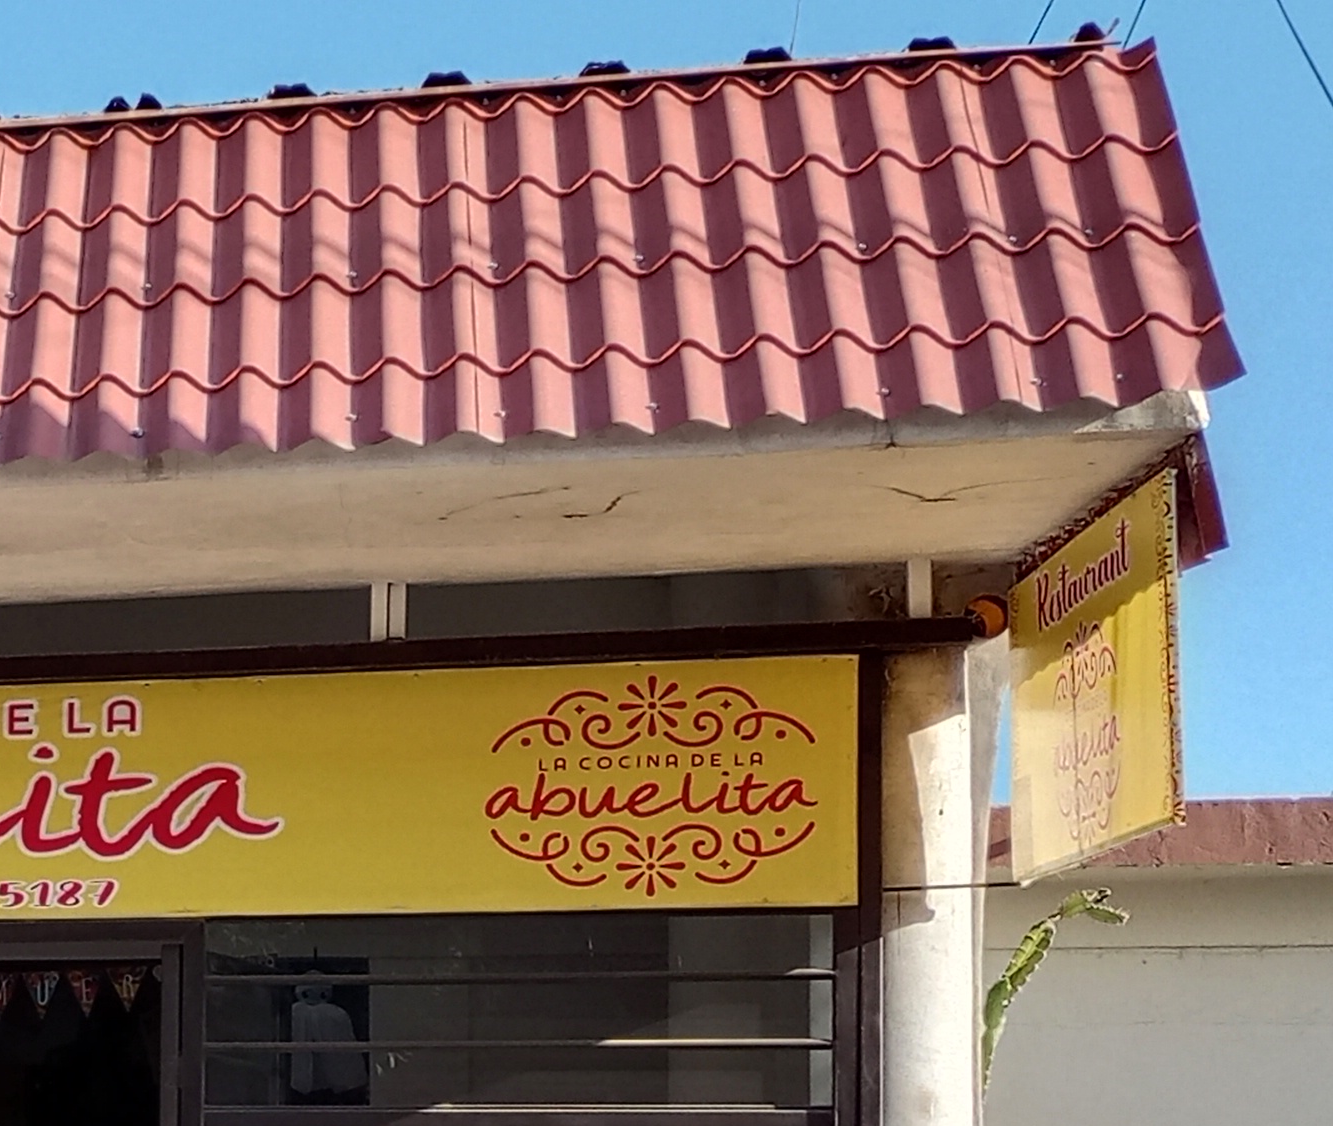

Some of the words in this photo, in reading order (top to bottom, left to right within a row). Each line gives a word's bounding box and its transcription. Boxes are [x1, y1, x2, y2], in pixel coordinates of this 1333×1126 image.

[1035, 519, 1130, 633] Restaurant
[66, 699, 138, 734] LA
[538, 757, 567, 772] LA
[578, 754, 679, 771] COCINA
[691, 753, 723, 769] DE
[734, 752, 765, 766] LA
[484, 768, 819, 821] abuelita
